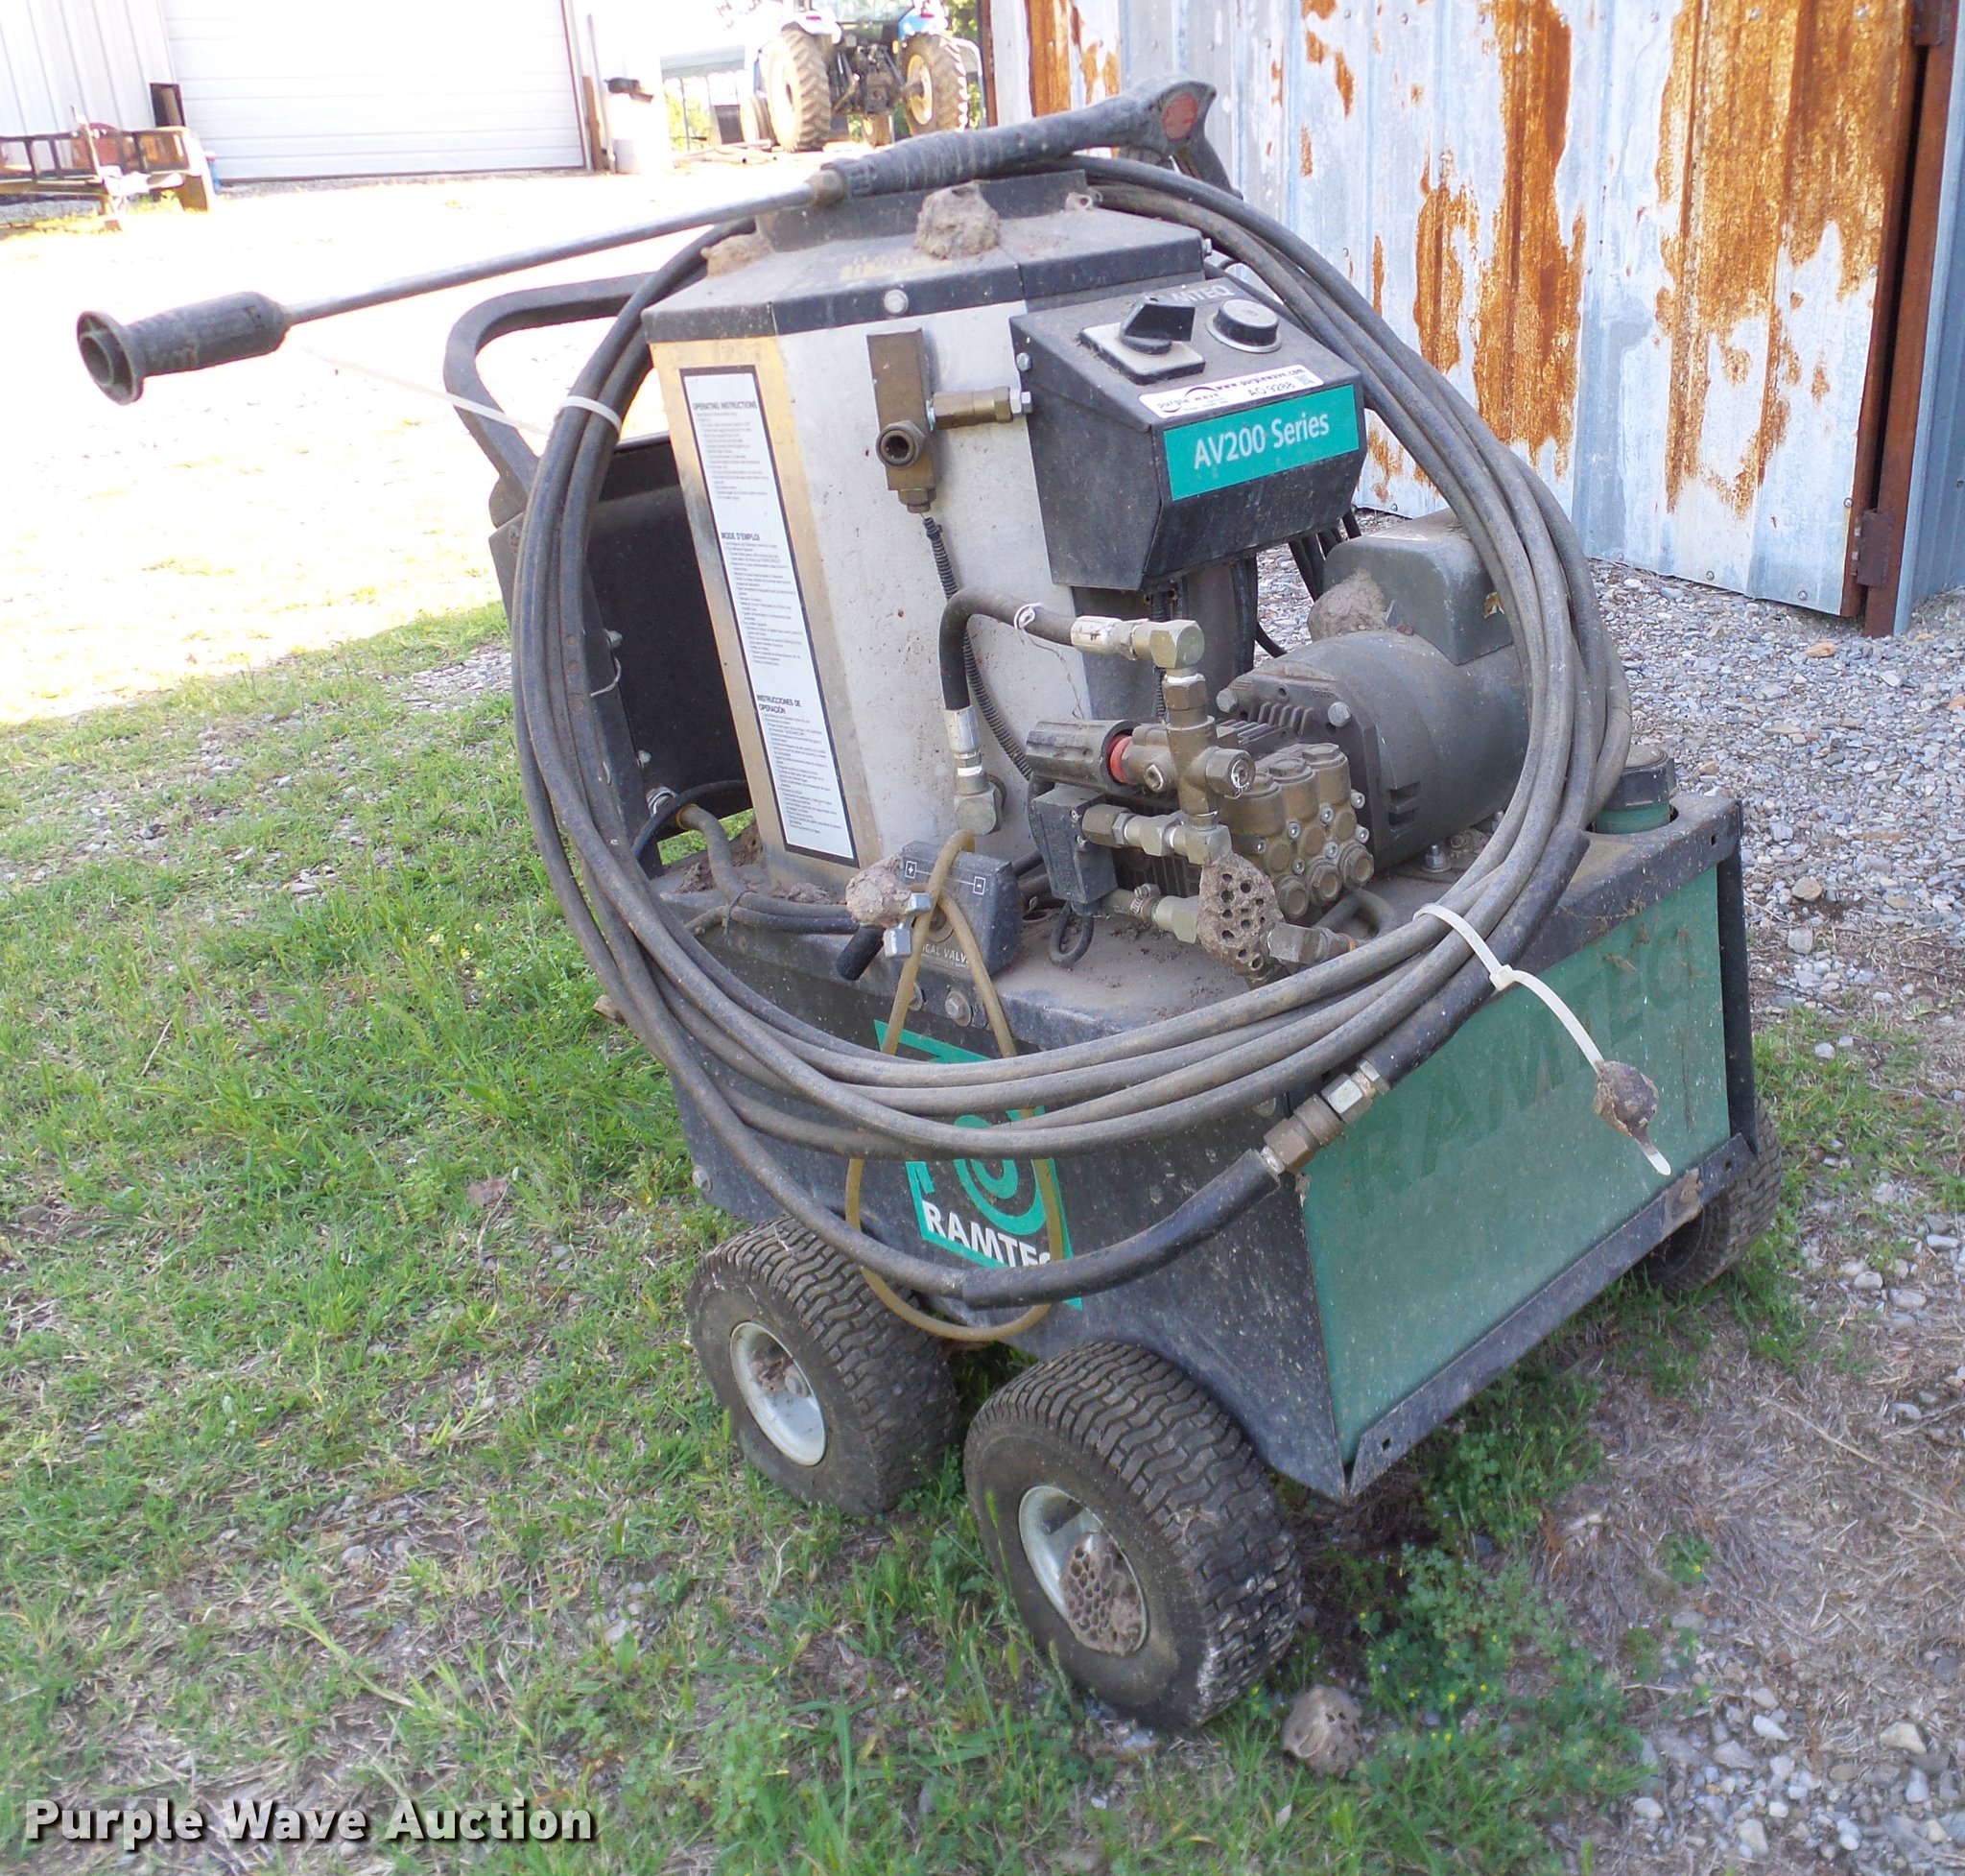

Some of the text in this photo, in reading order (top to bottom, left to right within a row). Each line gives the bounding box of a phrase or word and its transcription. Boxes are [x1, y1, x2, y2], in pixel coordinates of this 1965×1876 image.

[1170, 285, 1235, 302] MTEQ
[692, 400, 758, 411] OPERATING INSTRUCTIONS
[1194, 392, 1220, 402] wave
[1194, 413, 1330, 470] AV200 Series
[943, 947, 969, 964] VALV
